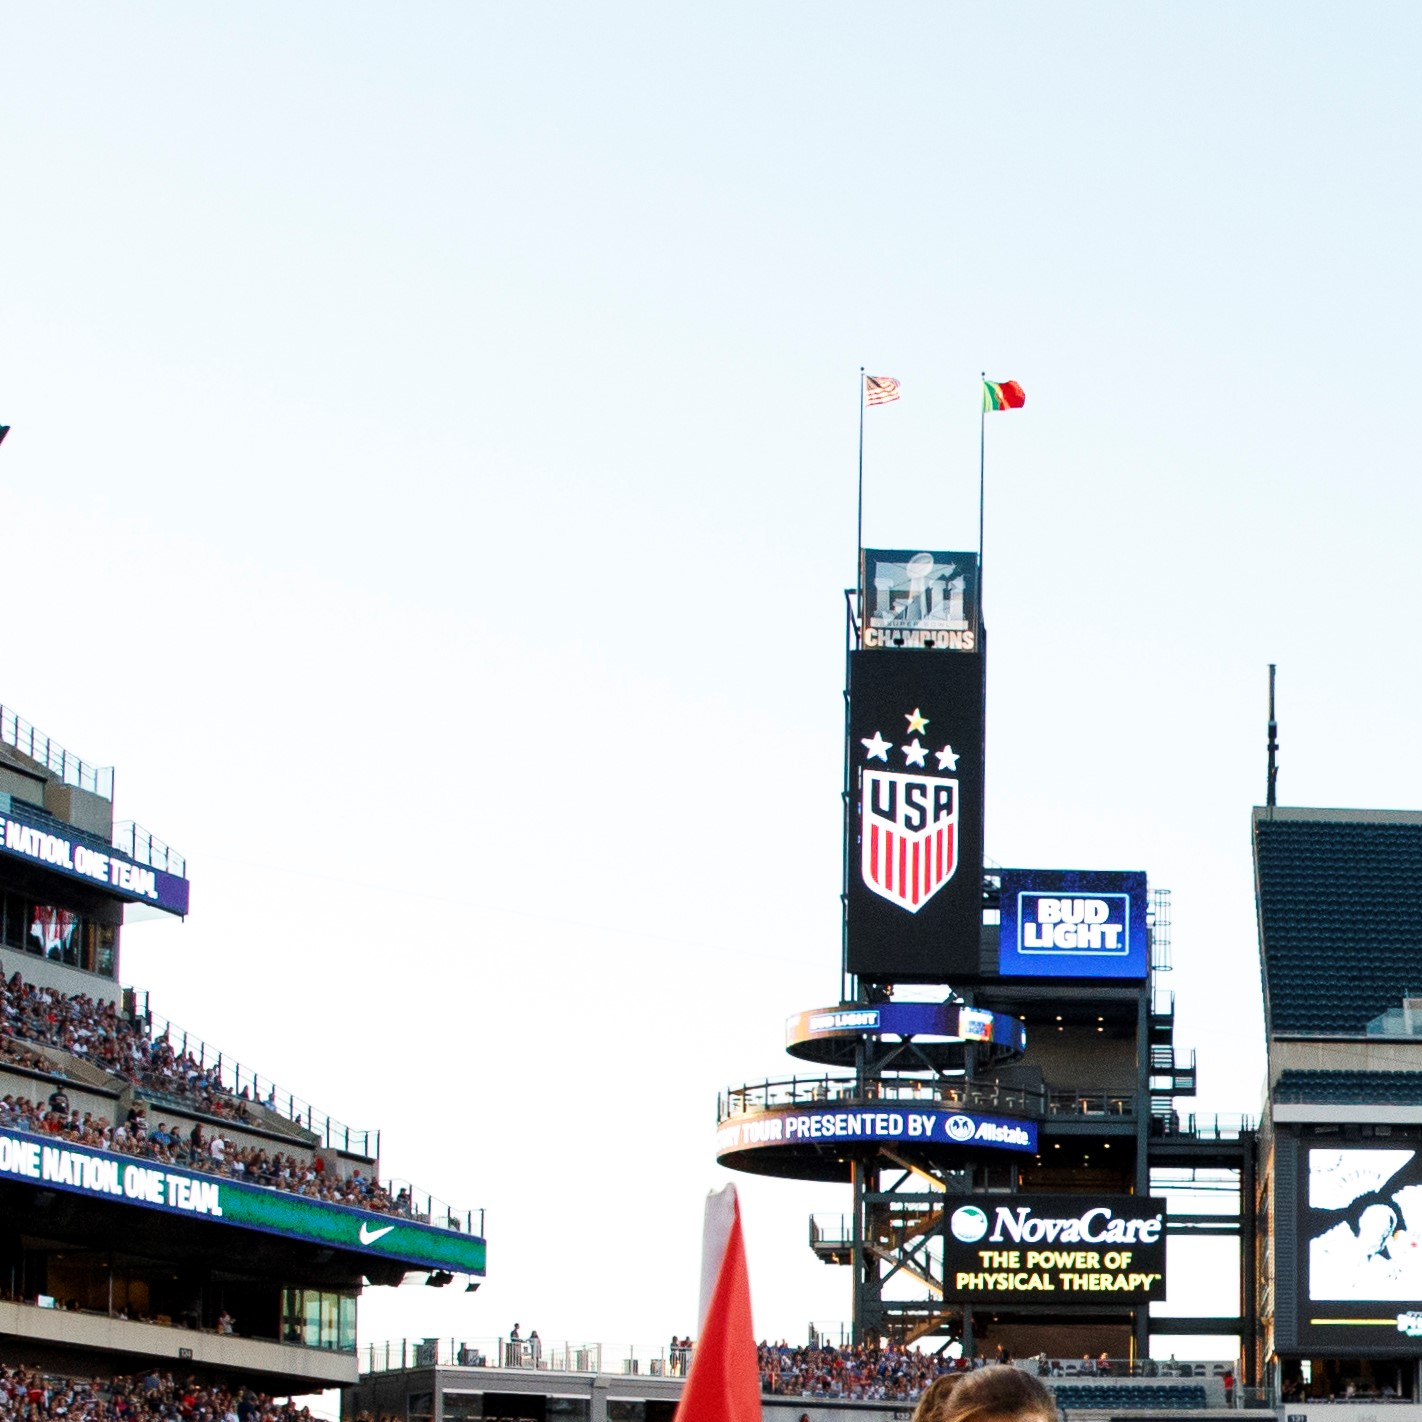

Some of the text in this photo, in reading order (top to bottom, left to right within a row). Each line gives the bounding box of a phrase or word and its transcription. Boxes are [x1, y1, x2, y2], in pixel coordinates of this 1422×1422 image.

[865, 627, 975, 650] CHAMPIONS
[871, 779, 954, 833] USA
[74, 845, 110, 882] ONE
[110, 858, 158, 900] TEAM.
[1038, 898, 1110, 924] BUD
[1024, 922, 1123, 949] LIGHT
[743, 1118, 783, 1143] TOUR
[785, 1113, 904, 1138] PRESENTED
[908, 1115, 937, 1137] BY
[0, 1136, 223, 1217] ONE NATION. ONE TEAM.
[989, 1206, 1163, 1243] NovaCare
[978, 1251, 1132, 1270] THE POWER OF
[956, 1273, 1055, 1291] PHYSICAL
